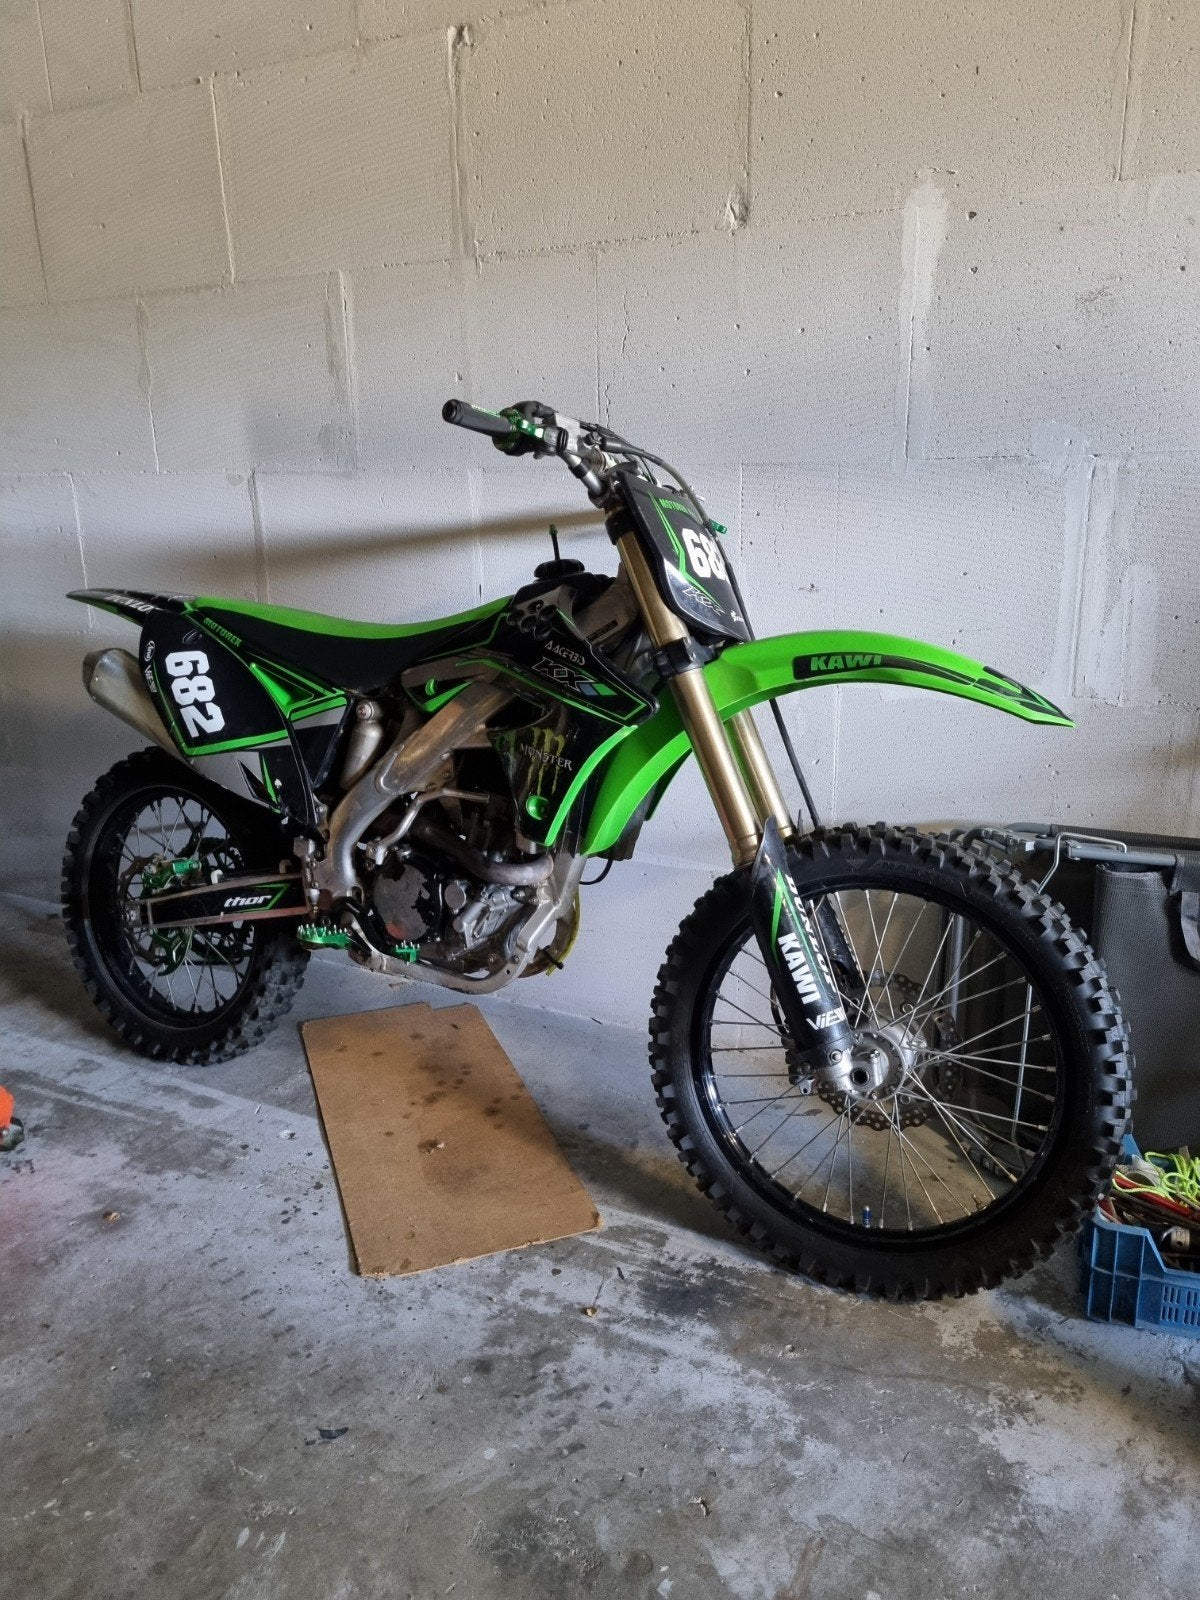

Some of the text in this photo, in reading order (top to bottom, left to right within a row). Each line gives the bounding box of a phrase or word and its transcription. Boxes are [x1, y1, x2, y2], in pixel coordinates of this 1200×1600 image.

[165, 650, 225, 738] 682
[810, 655, 882, 671] KAWI
[778, 932, 821, 1005] KAWI
